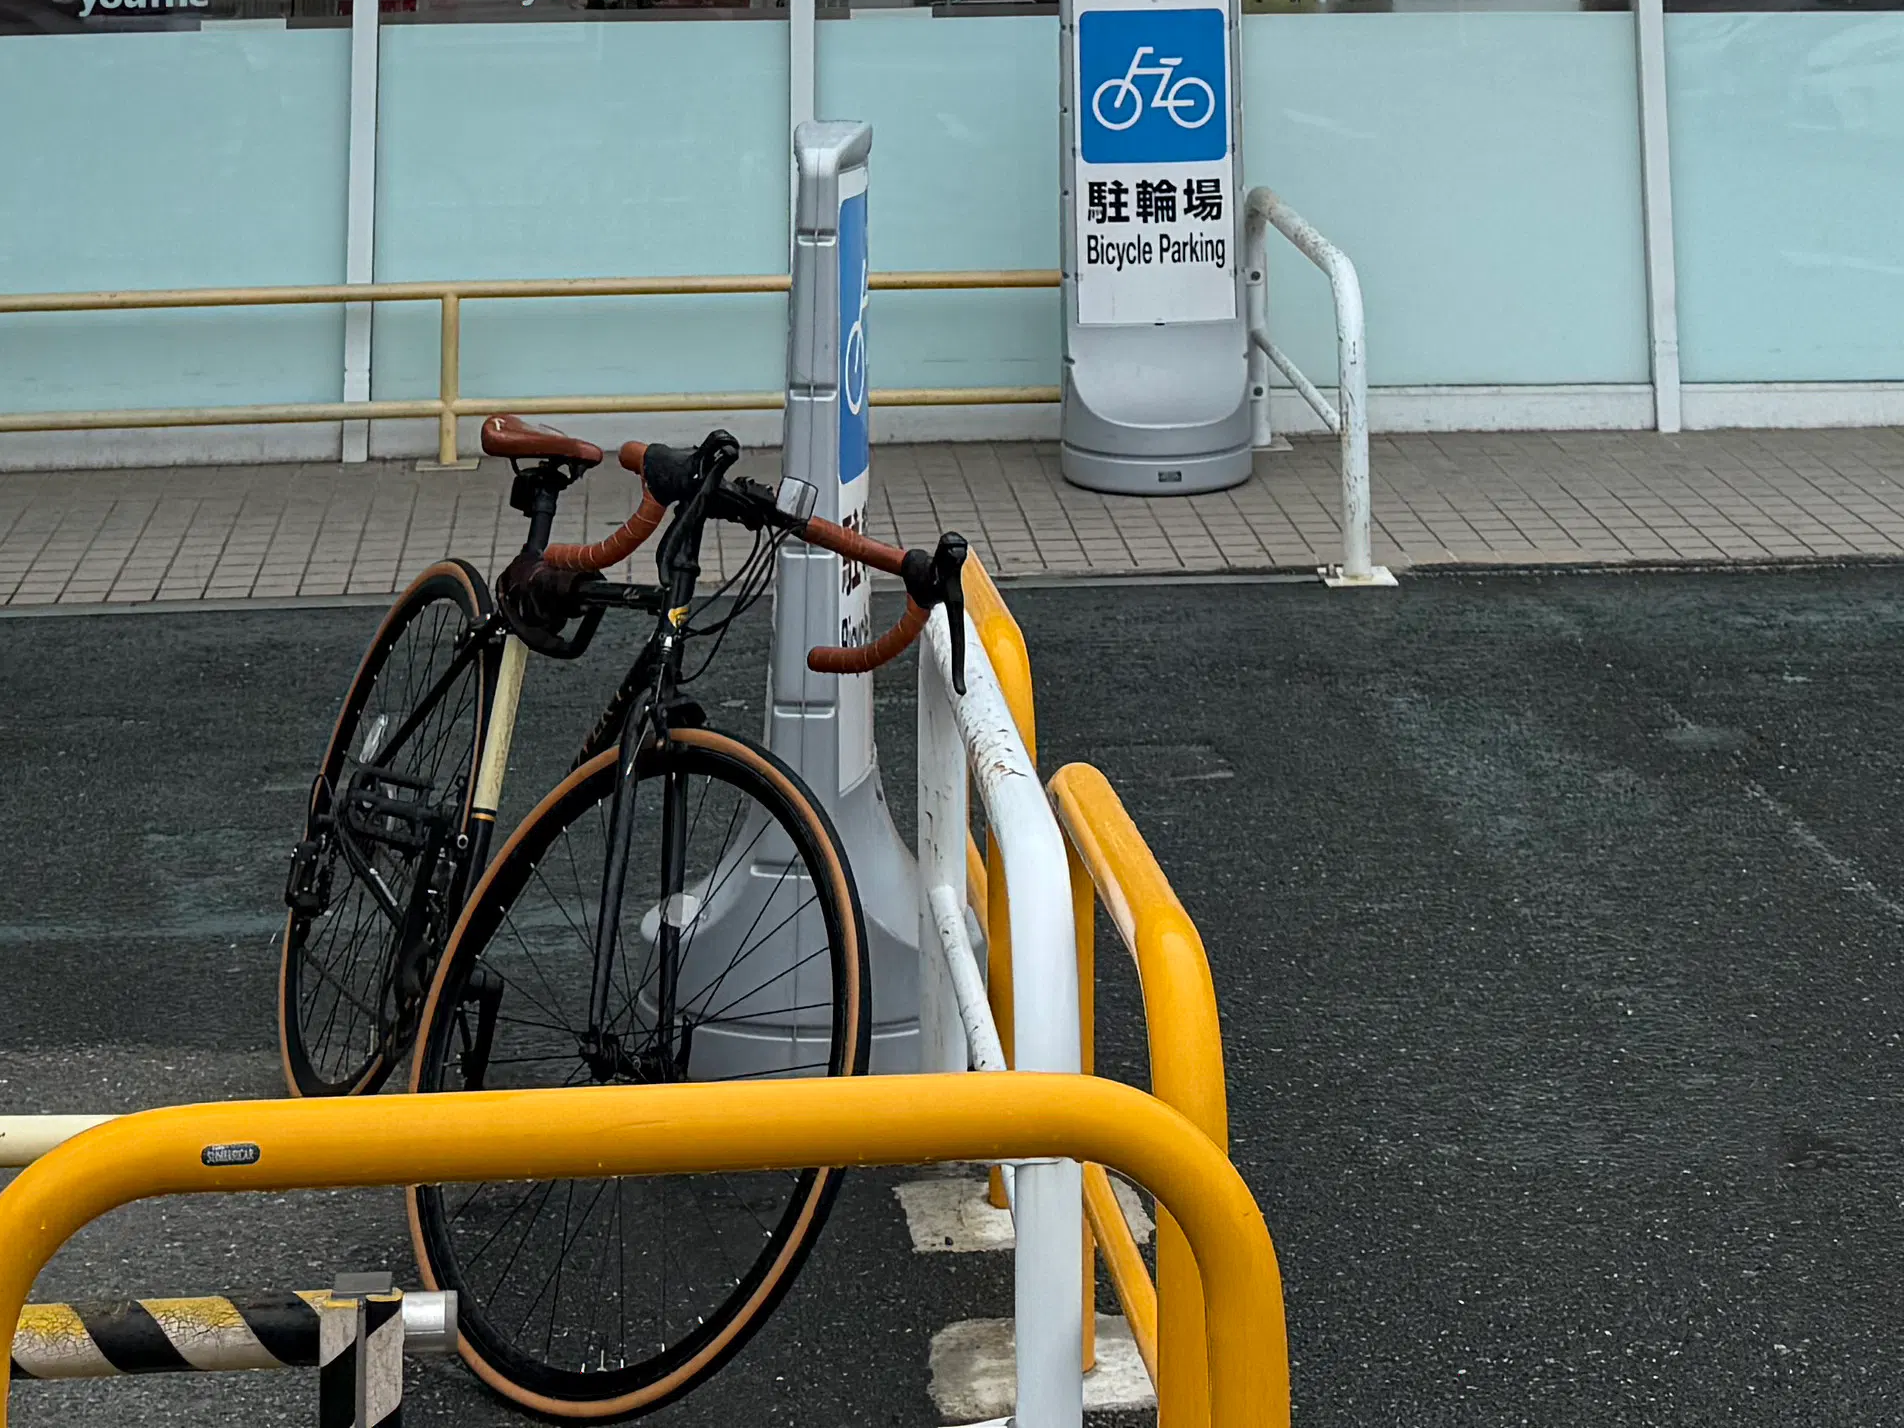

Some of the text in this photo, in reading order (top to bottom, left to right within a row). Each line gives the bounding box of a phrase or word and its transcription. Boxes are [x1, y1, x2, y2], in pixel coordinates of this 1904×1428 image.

[1087, 178, 1223, 225] 駐輪場
[1087, 231, 1226, 272] Bicycle Parking
